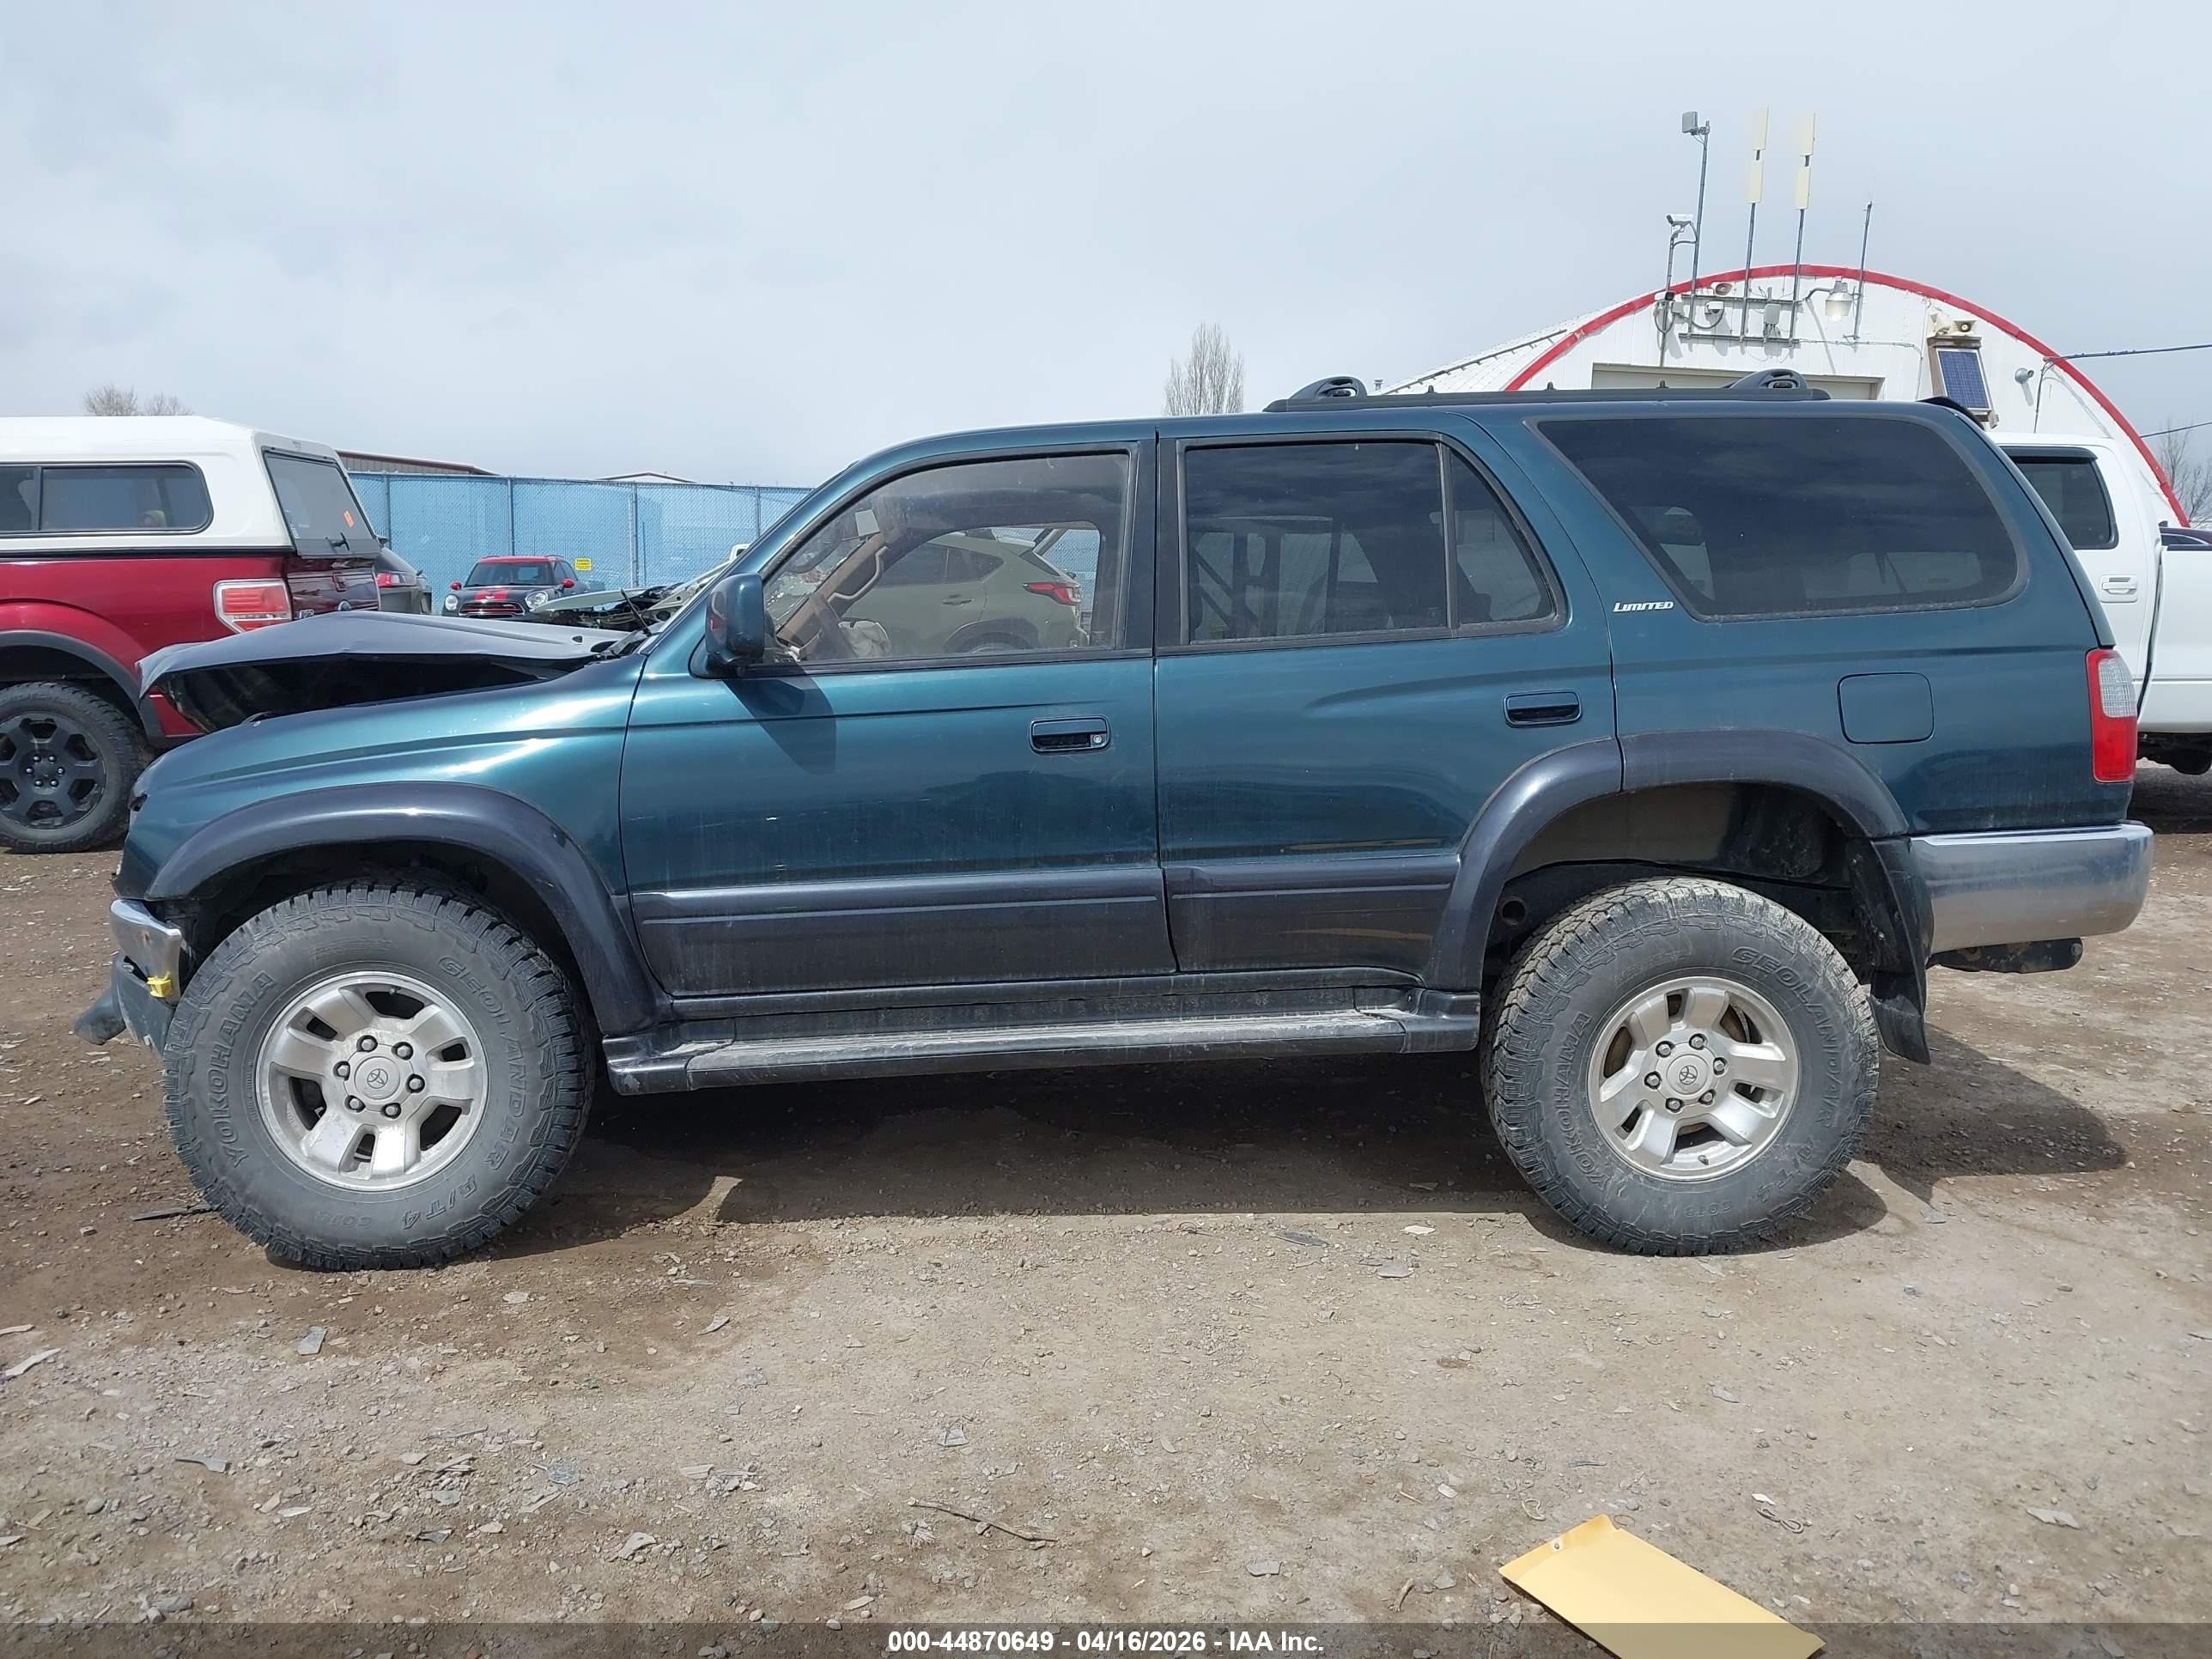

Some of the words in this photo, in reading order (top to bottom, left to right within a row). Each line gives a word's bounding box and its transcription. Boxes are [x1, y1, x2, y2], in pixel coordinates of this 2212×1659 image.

[207, 969, 277, 1169] YOKOHAMA
[439, 956, 526, 1171] GEOLANDAR
[1555, 1012, 1607, 1191] YOKOHAMA
[1729, 945, 1841, 1128] GEOLANDAR
